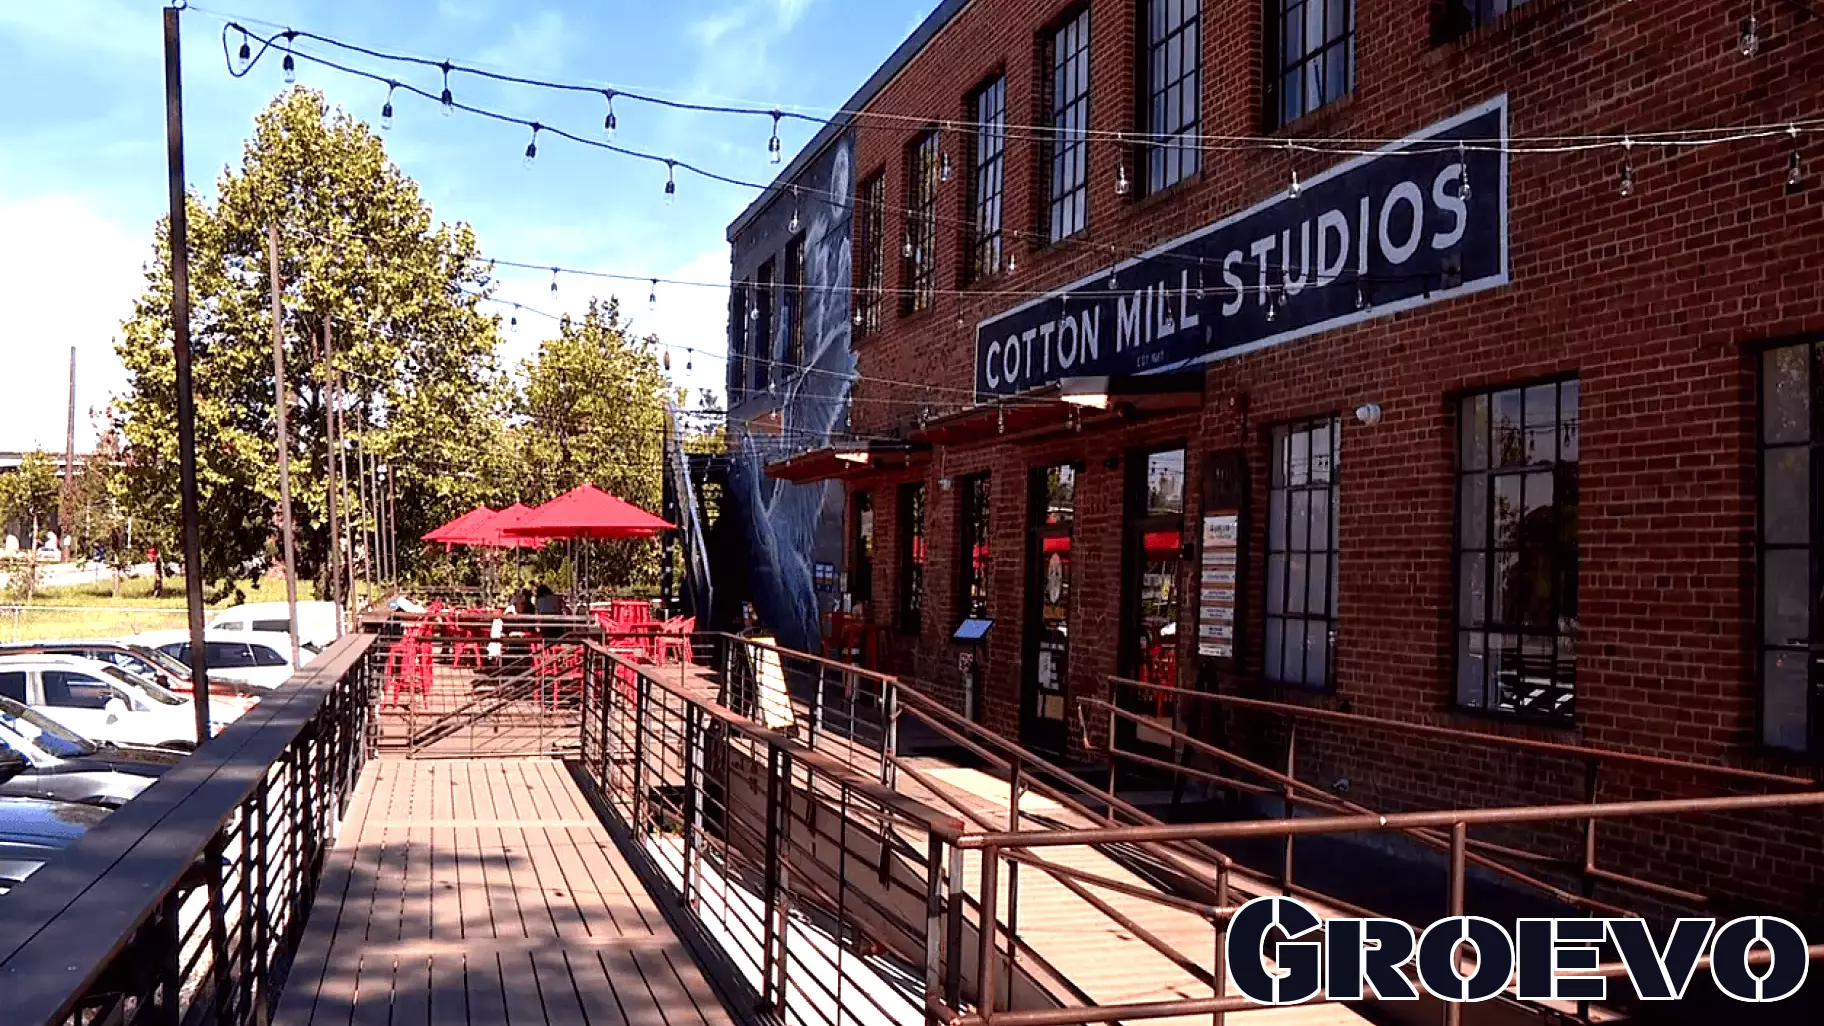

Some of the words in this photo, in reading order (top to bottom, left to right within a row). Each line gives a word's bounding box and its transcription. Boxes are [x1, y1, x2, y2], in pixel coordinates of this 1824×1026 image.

[986, 305, 1100, 389] COTTON
[1116, 269, 1200, 353] MILL
[1222, 163, 1468, 316] STUDIOS
